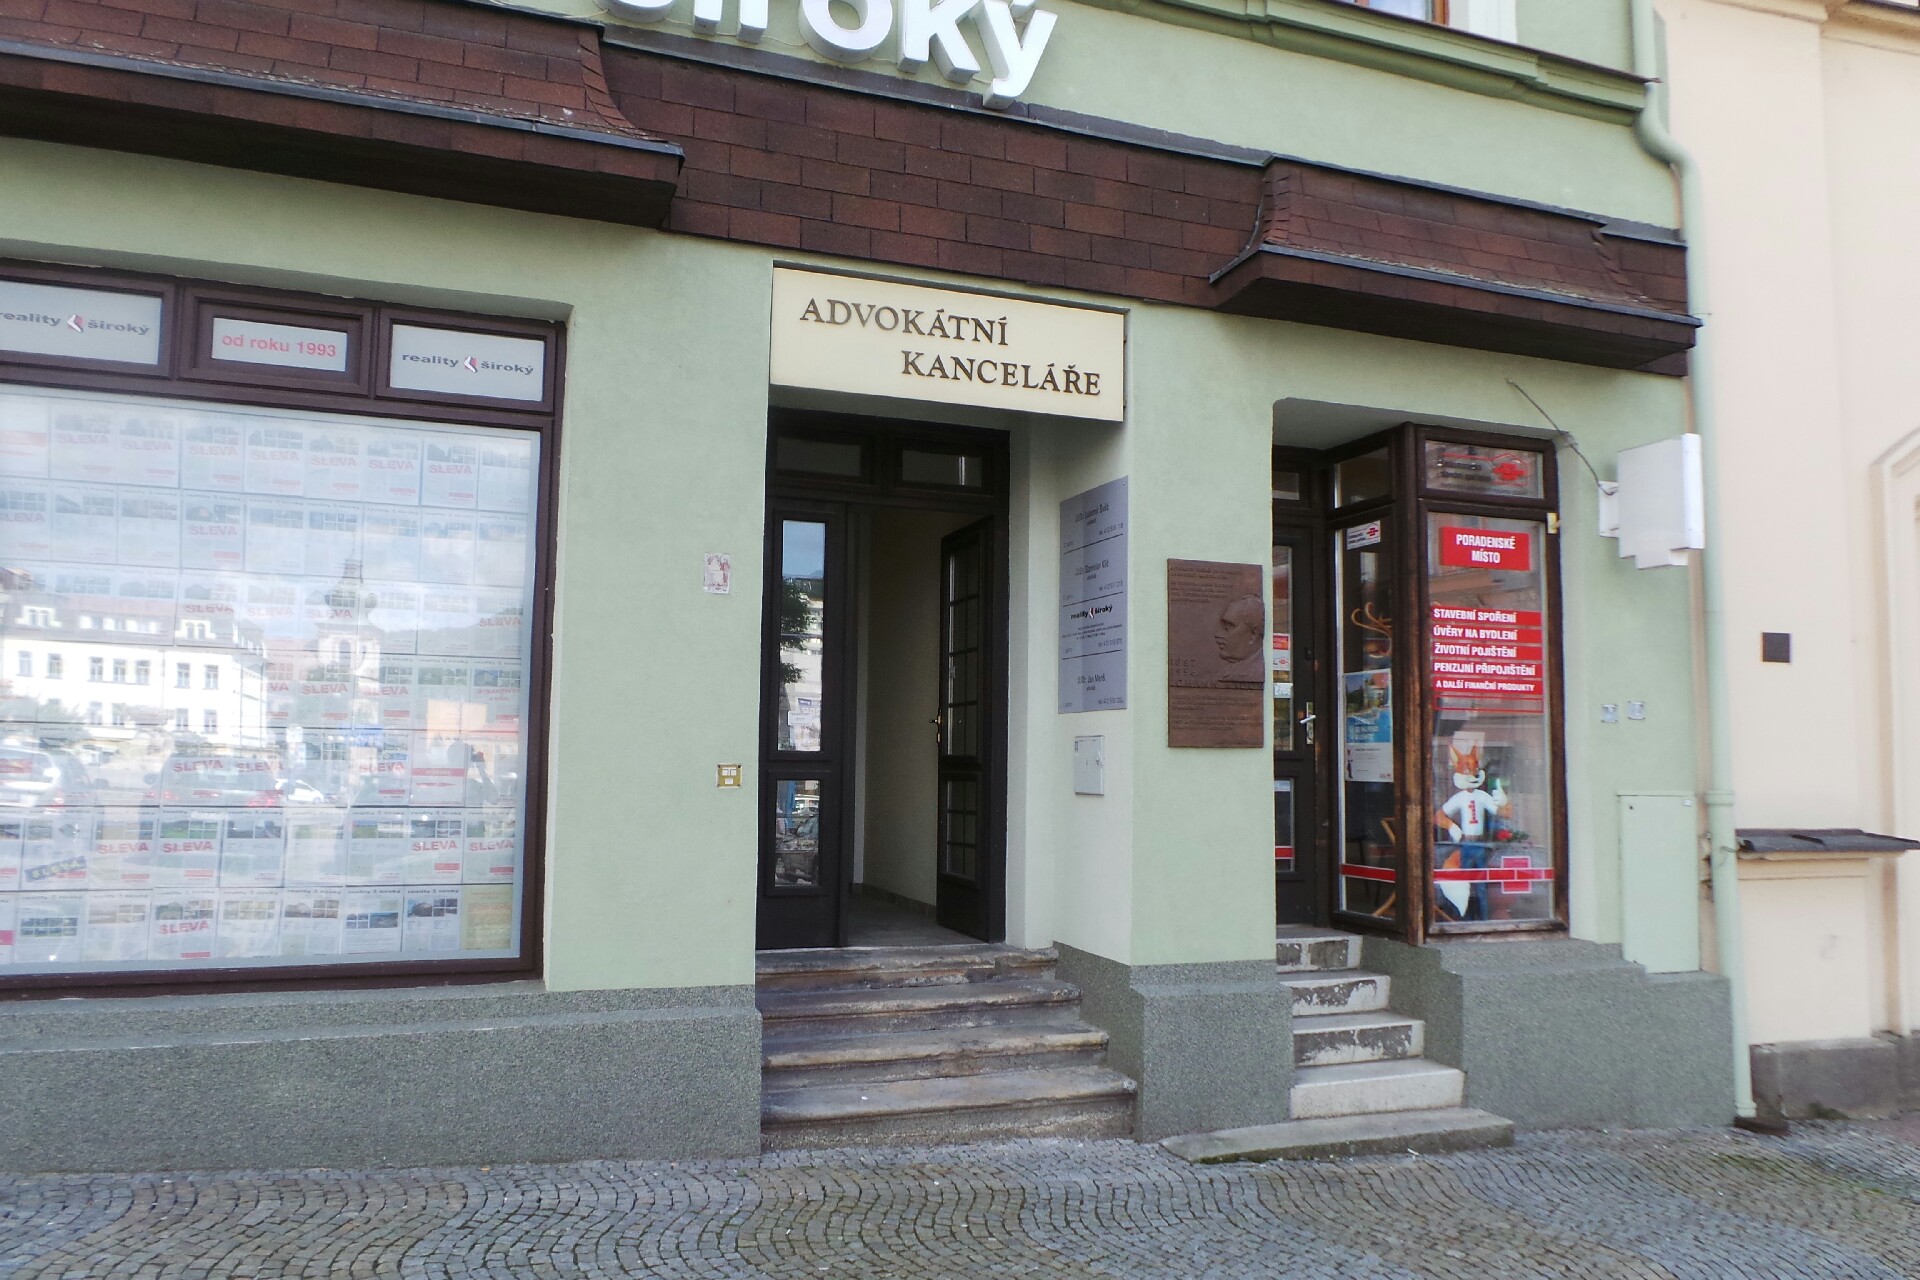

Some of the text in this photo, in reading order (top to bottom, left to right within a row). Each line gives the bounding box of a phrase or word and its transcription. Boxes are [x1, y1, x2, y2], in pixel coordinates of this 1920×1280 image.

[88, 320, 150, 336] široký
[800, 297, 1009, 346] ADVOKÁTNÍ
[222, 335, 336, 358] od roku 1993
[402, 354, 534, 376] reality široký
[901, 350, 1101, 396] KANCELÁŘE
[311, 456, 357, 467] SLEVA
[369, 459, 414, 471] SLEVA
[429, 464, 473, 475] SLEVA
[190, 525, 238, 536] SLEVA
[1456, 535, 1516, 550] PORADENSKÉ
[1471, 549, 1501, 564] MÍSTO
[479, 617, 522, 628] SLEVA
[1433, 608, 1517, 623] STAVEBNÍ SPOŘENÍ
[1433, 625, 1518, 641] ÚVĚRY NA BYDLENÍ
[1434, 643, 1517, 658] ŽIVOTNÍ POJIŠTĚNÍ
[1434, 662, 1536, 676] PENZIJNÍ PŘIPOJIŠTĚNÍ
[301, 683, 349, 695] SLEVA
[363, 686, 409, 697] SLEVA
[1436, 680, 1535, 692] A DALŠÍ FINANČNÍ PRODUKTY
[1468, 800, 1478, 824] 1
[99, 842, 150, 854] SLEVA
[163, 841, 214, 853] SLEVA
[412, 840, 458, 852] SLEVA
[469, 840, 514, 852] SLEVA
[160, 920, 209, 934] SLEVA
